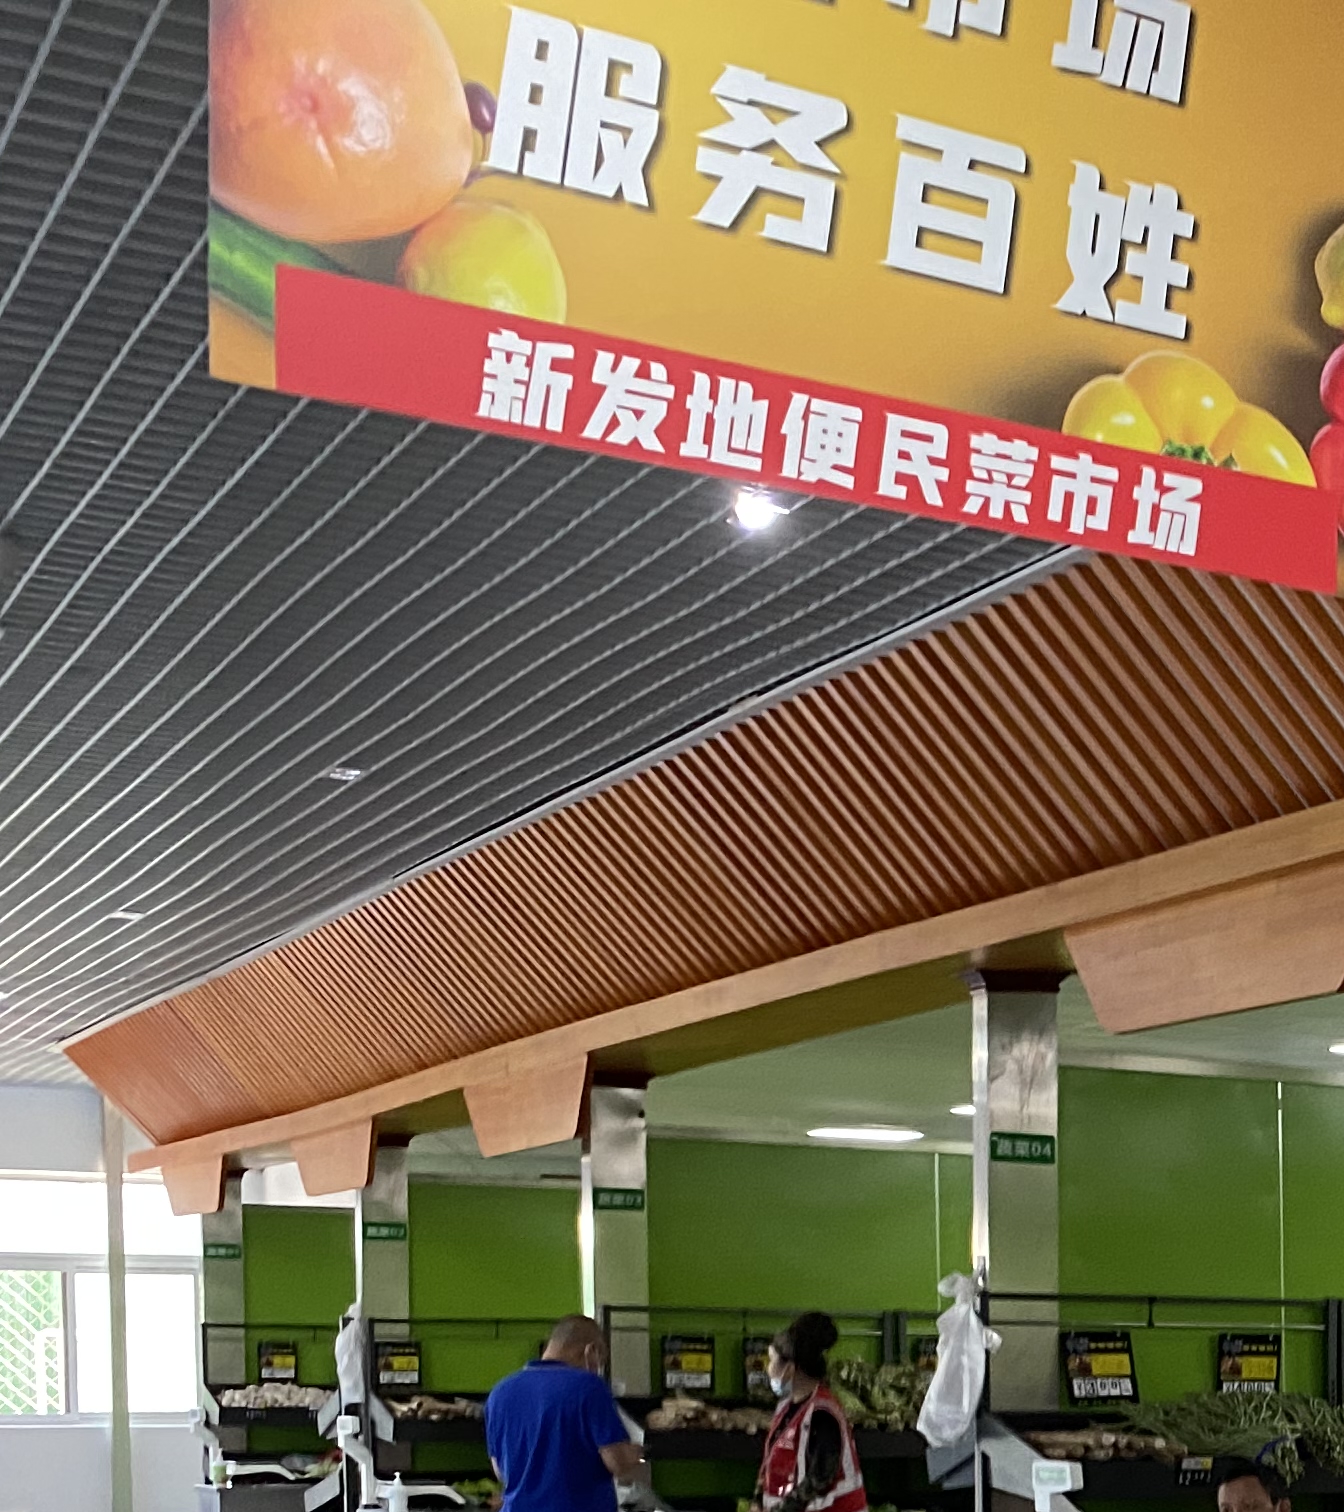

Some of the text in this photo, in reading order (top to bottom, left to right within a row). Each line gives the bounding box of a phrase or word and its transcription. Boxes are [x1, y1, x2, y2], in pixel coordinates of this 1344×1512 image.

[484, 5, 1195, 339] 服务百姓
[476, 329, 1203, 557] 新发地便民菜市场
